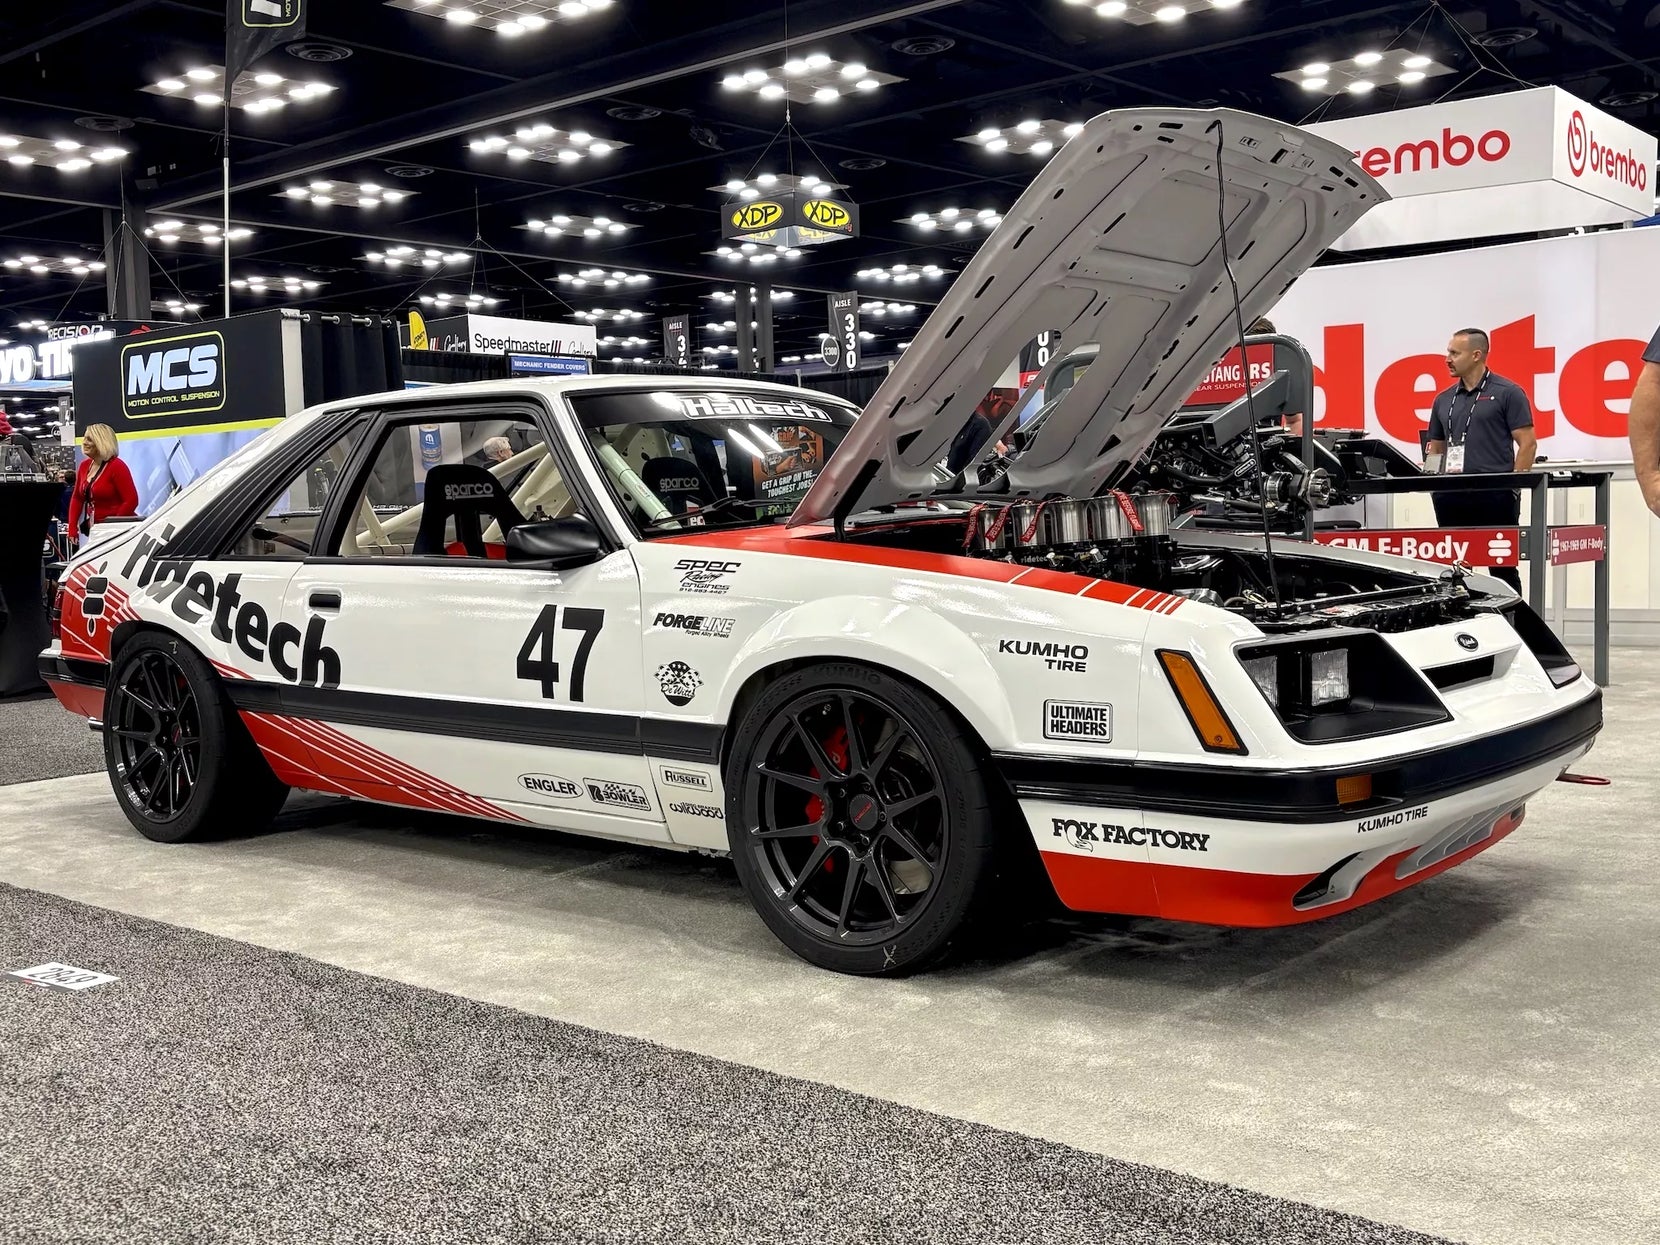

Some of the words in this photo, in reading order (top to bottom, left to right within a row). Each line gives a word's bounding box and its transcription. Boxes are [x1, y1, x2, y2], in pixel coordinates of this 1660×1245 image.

[1353, 127, 1511, 178] embo
[1589, 130, 1647, 192] brembo
[738, 205, 778, 228] XDP
[809, 201, 845, 225] XDP
[834, 298, 852, 308] AISLE
[669, 321, 682, 330] AISLE
[474, 333, 552, 353] Speedmaster
[845, 313, 857, 371] 330
[128, 343, 219, 395] MCS
[514, 360, 543, 369] MECHANIC
[544, 362, 565, 370] FENDER
[565, 363, 586, 371] COVERS
[128, 399, 150, 407] MOTION
[151, 395, 179, 405] CONTROL
[181, 390, 220, 402] SUSPENSION
[685, 396, 827, 420] Haltech
[444, 482, 494, 500] sparco
[659, 477, 699, 492] sparco
[762, 479, 773, 490] GET
[773, 479, 778, 487] A
[778, 475, 792, 486] GRIP
[793, 474, 802, 483] ON
[767, 484, 796, 498] TOUGHEST
[121, 523, 341, 688] ridetech
[653, 612, 736, 633] FORGELINE
[516, 603, 605, 703] 47
[998, 639, 1089, 660] KUMHO
[1044, 659, 1087, 673] TIRE
[1050, 705, 1107, 722] ULTIMATE
[1050, 719, 1107, 737] HEADERS
[523, 776, 578, 796] ENGLER
[665, 770, 707, 786] RUSSELL
[602, 790, 648, 805] BOWLER
[669, 802, 724, 819] wilwood
[1357, 812, 1404, 834] KUMHO
[1404, 805, 1429, 822] TIRE
[1051, 818, 1099, 842] FOX
[1101, 823, 1210, 852] FACTORY
